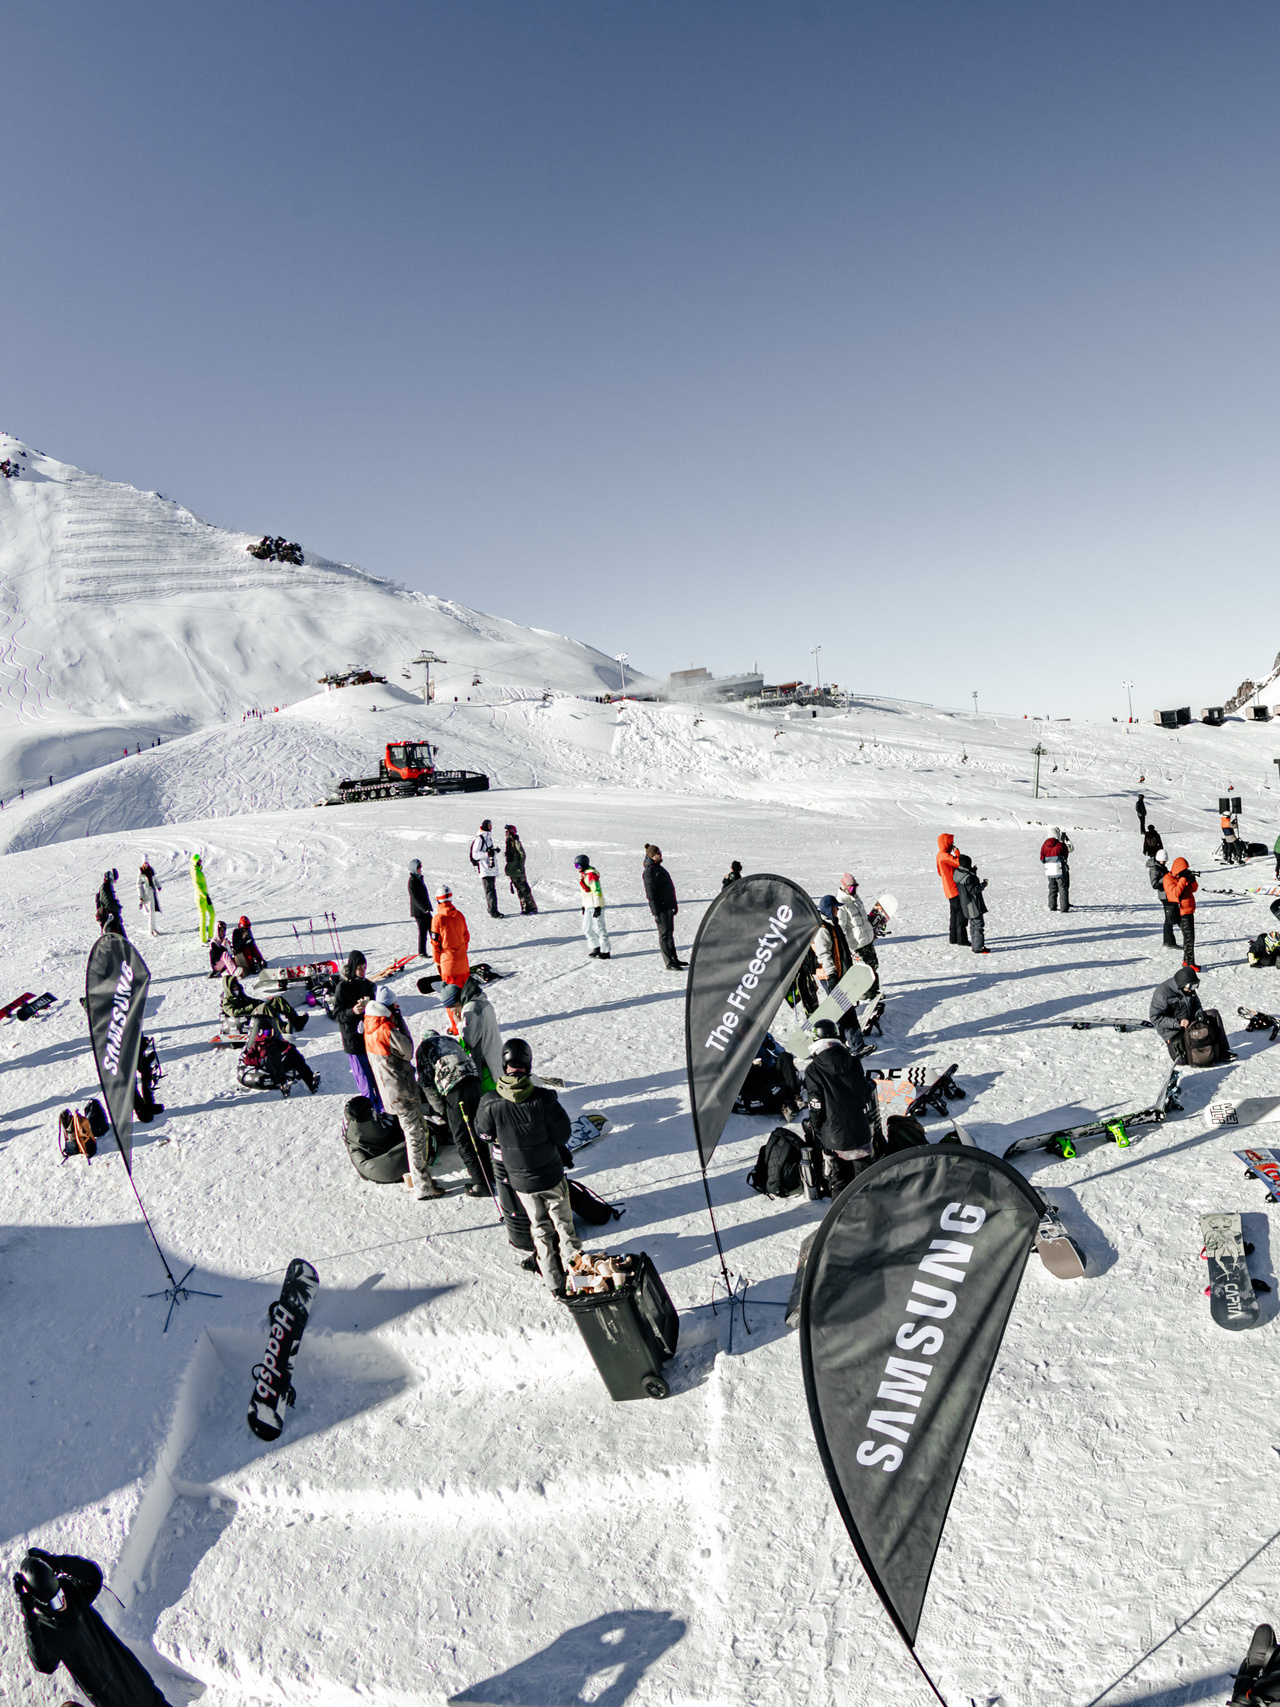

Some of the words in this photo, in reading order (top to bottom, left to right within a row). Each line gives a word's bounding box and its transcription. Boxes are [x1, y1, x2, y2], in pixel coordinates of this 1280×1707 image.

[103, 960, 135, 1076] SAMSUNG
[704, 1011, 740, 1052] The
[726, 904, 794, 1011] Freestyle
[856, 1201, 987, 1473] SAMSUNG
